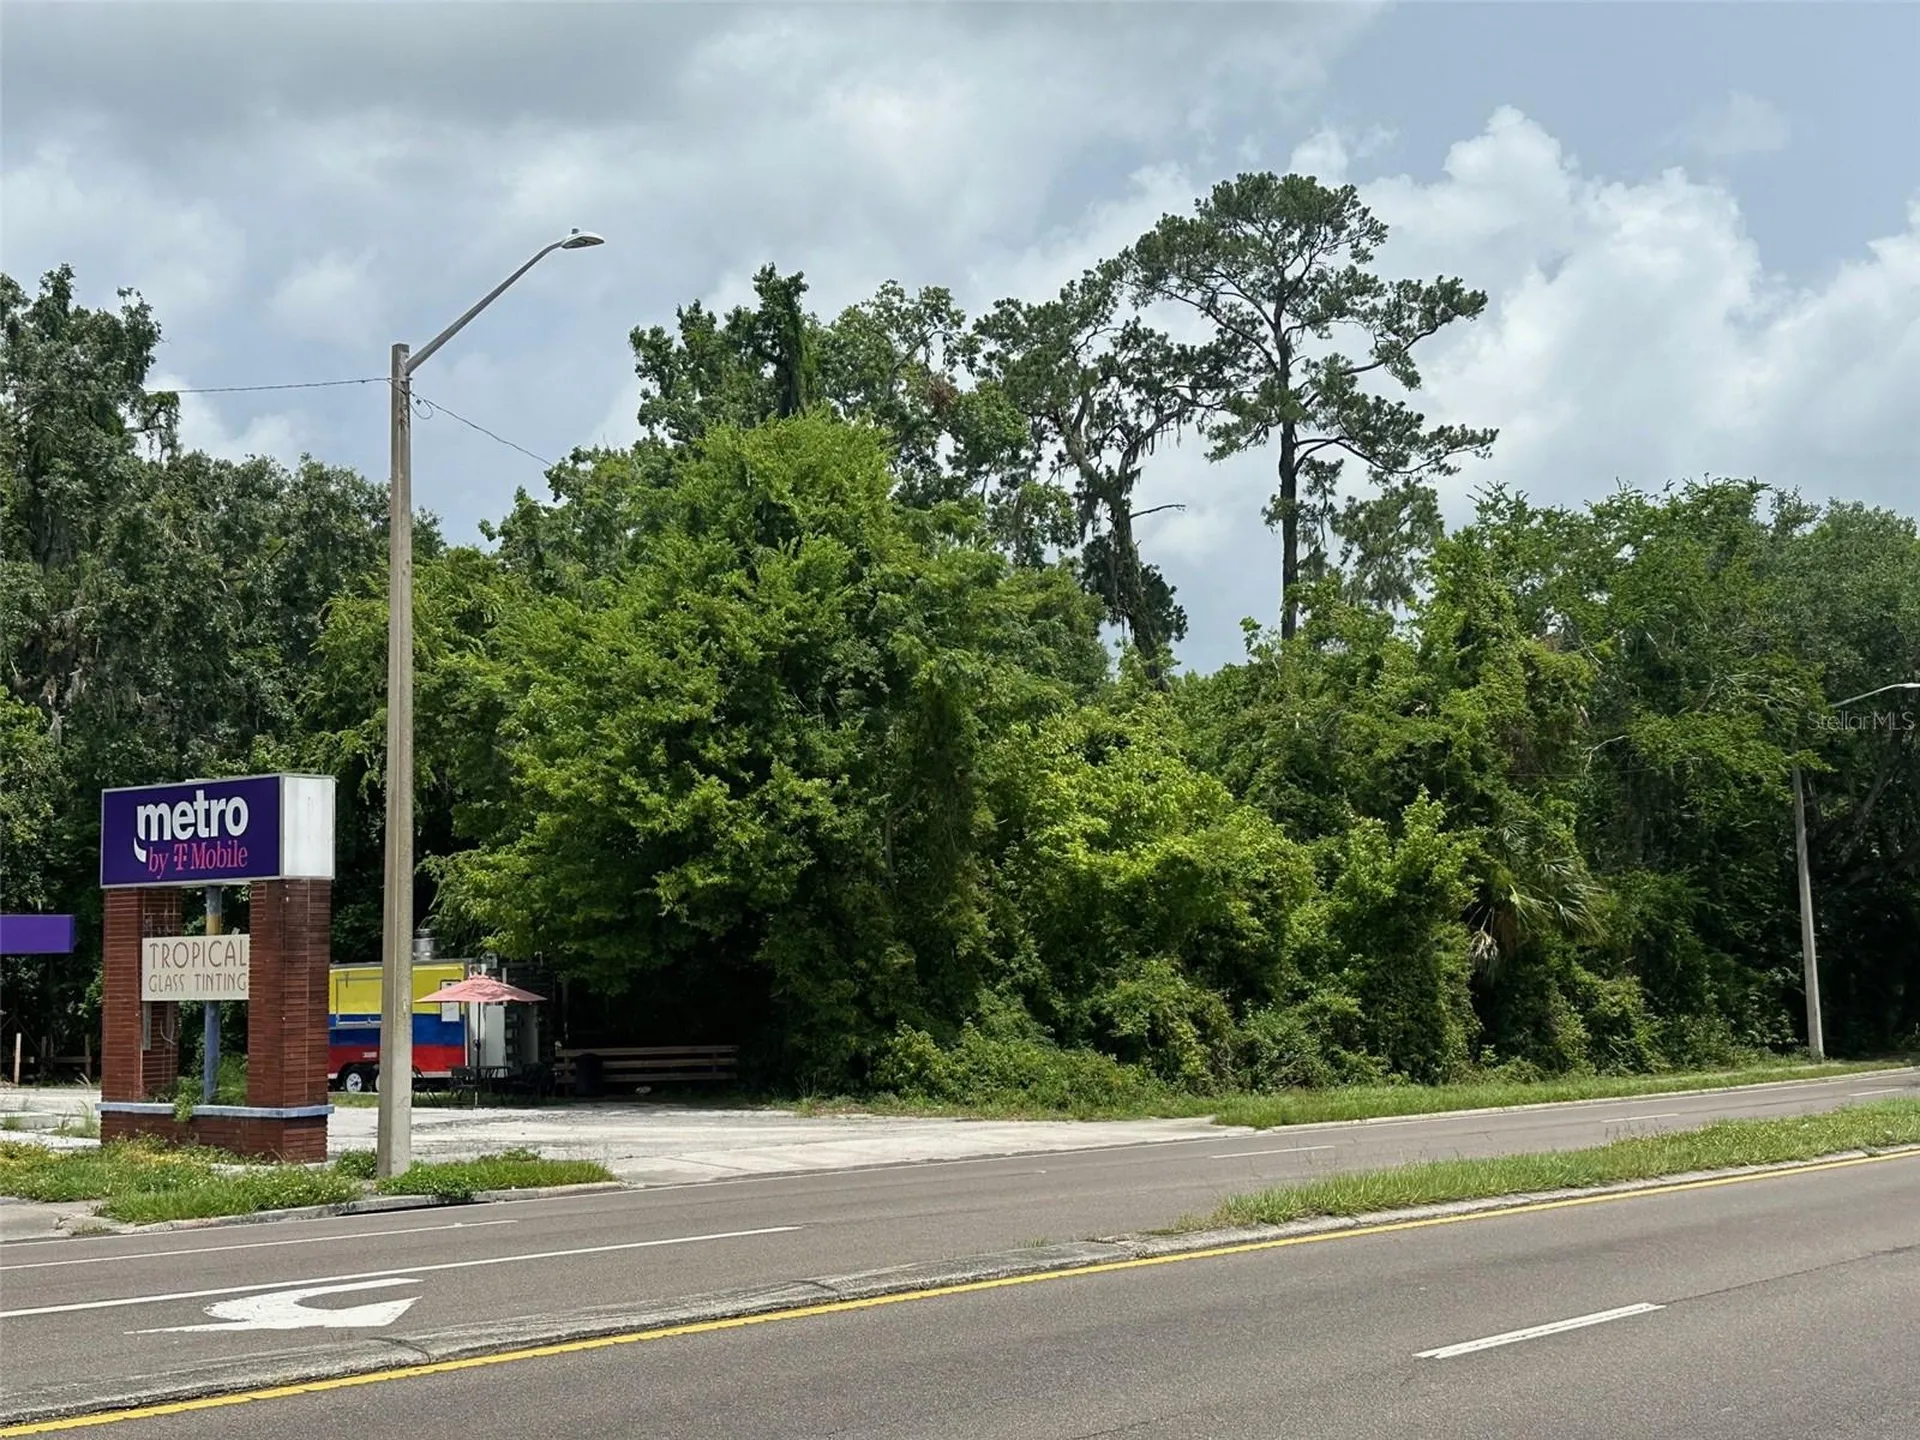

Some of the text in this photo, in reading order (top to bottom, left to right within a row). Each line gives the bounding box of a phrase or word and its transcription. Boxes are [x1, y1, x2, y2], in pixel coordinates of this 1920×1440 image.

[136, 789, 249, 842] metro
[148, 846, 168, 879] by
[149, 940, 247, 969] TROPICAL
[148, 972, 247, 993] GLASS TINTING
